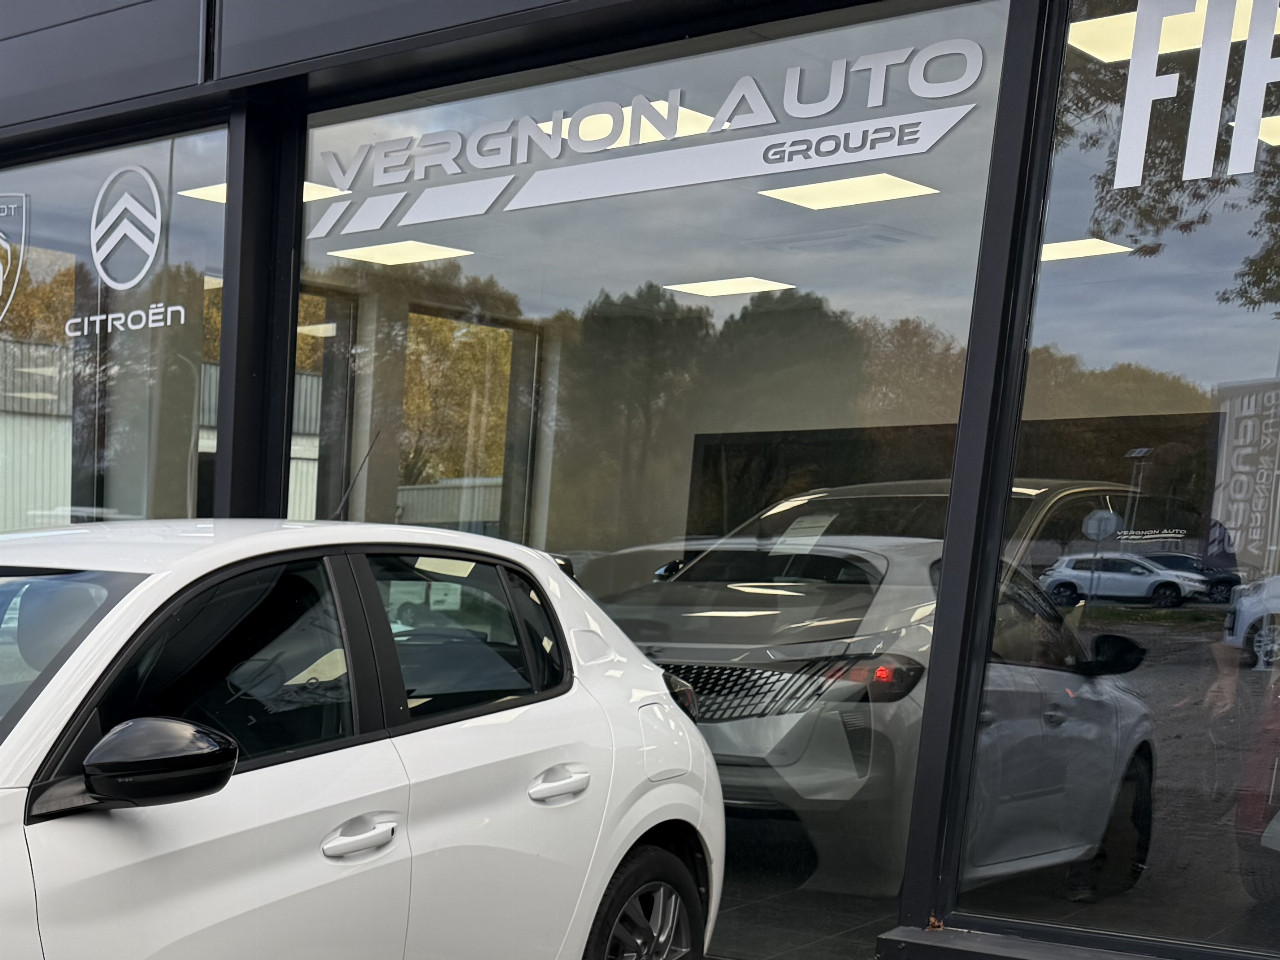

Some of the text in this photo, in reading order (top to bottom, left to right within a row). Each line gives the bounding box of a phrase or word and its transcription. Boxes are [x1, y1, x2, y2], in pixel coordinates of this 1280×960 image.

[321, 39, 983, 192] VERGNON AUTO
[763, 122, 922, 164] GROUPE
